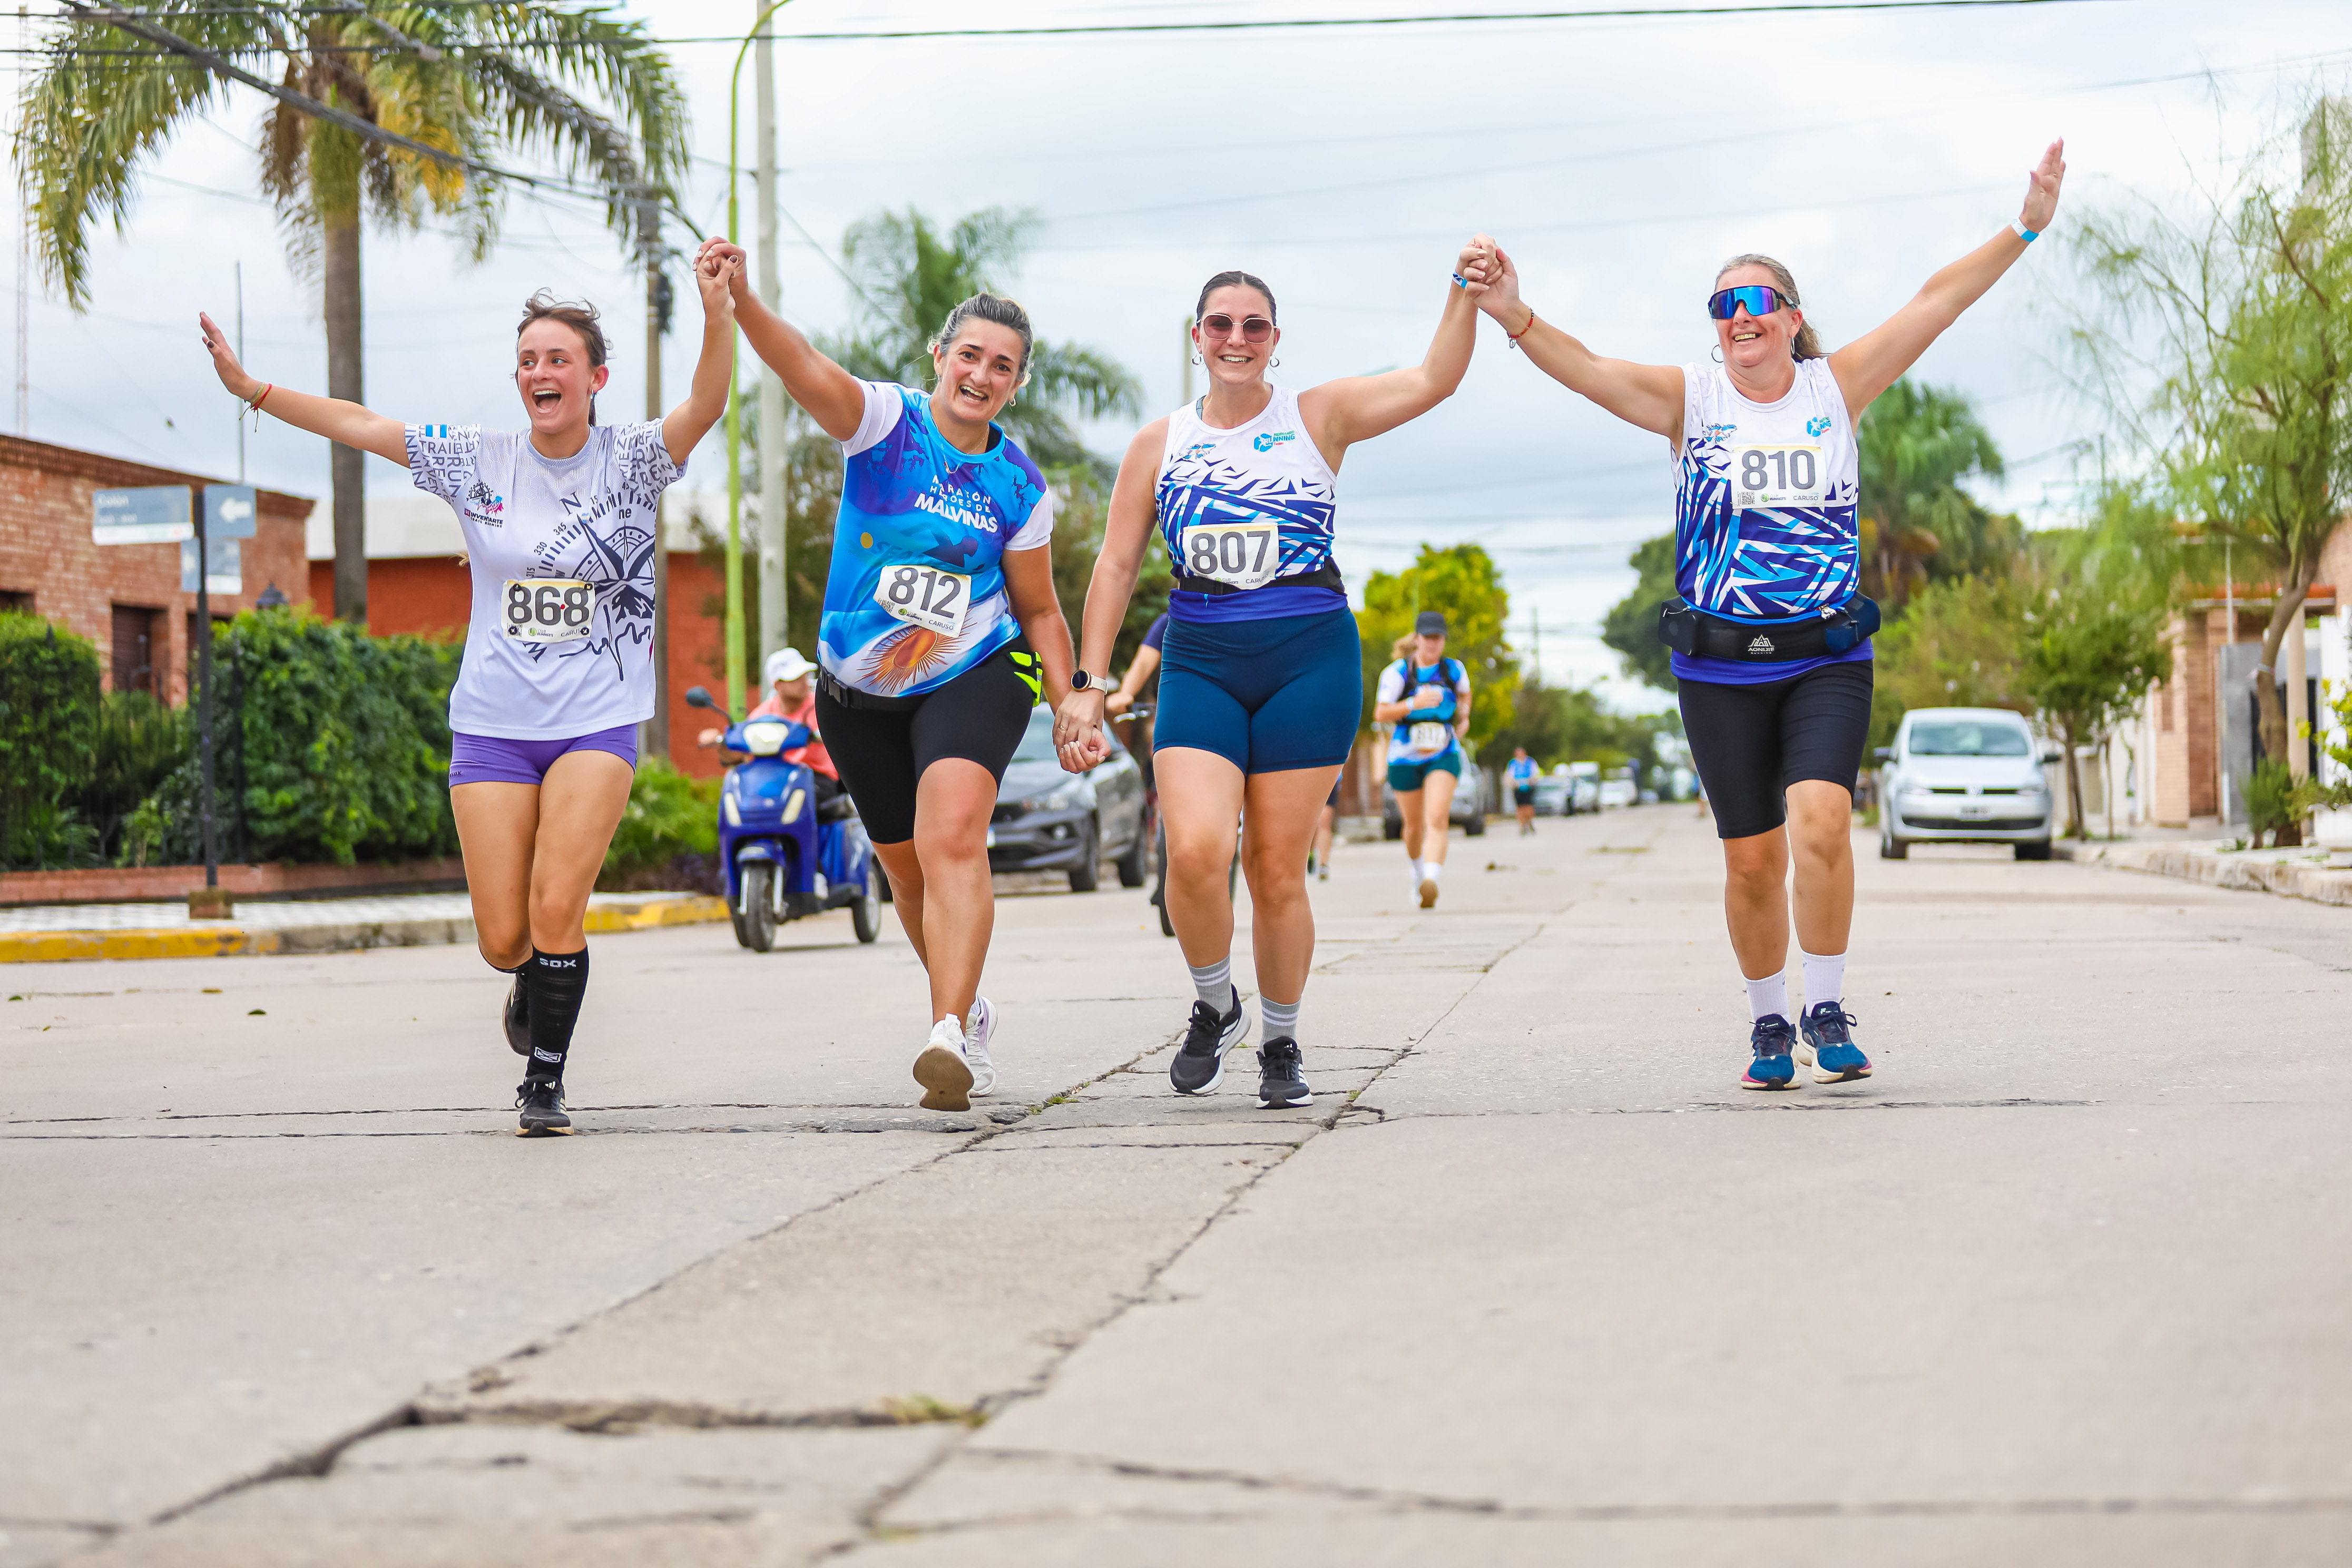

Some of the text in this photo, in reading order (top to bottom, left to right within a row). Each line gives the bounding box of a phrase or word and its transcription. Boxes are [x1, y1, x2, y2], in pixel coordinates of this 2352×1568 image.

[1741, 449, 1816, 491] 810
[619, 507, 632, 520] ne
[914, 493, 998, 533] MALVINAS
[976, 504, 991, 513] DE
[553, 522, 566, 536] 345
[534, 542, 547, 556] 330
[1191, 530, 1271, 574] 807
[888, 567, 961, 619] 812
[507, 585, 590, 626] 868
[928, 619, 954, 631] CARUSO
[539, 957, 577, 968] SOX
